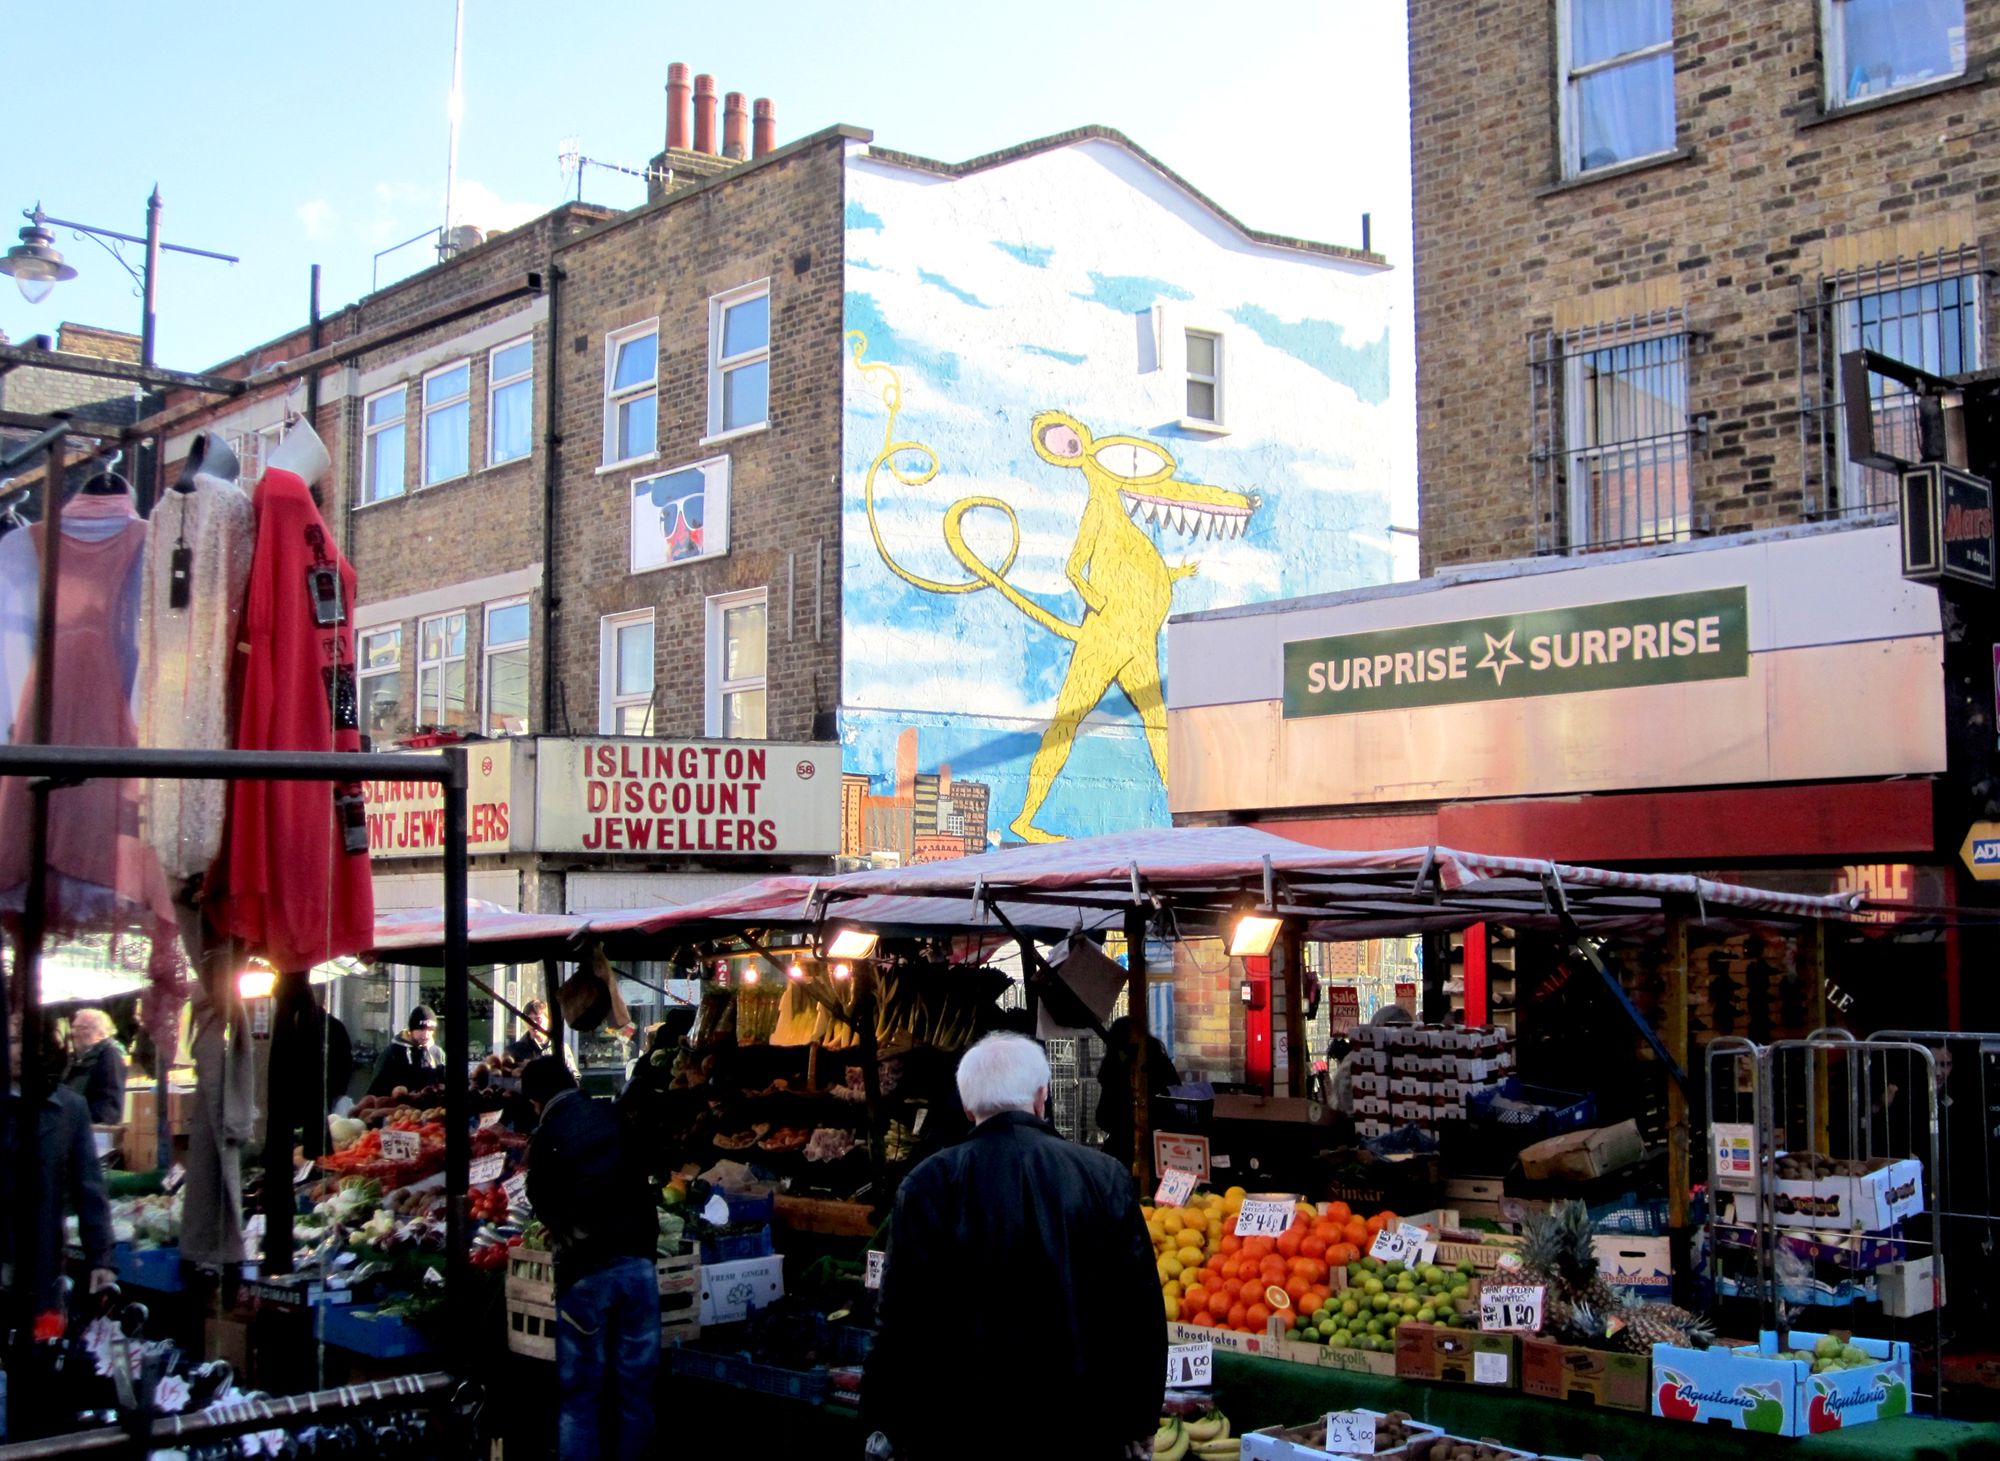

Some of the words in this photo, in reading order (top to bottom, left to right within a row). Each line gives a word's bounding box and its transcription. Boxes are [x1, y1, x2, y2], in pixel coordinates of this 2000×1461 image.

[1944, 505, 1992, 541] Mars
[1307, 645, 1468, 694] SURPRISE
[1529, 616, 1721, 670] SURPRISE
[584, 745, 766, 781] ISLINGTON
[797, 765, 814, 776] 58
[587, 780, 762, 815] DISCOUNT
[582, 817, 778, 851] JEWELLERS
[1880, 911, 1896, 923] ON
[1332, 990, 1357, 1003] sale
[1256, 1214, 1266, 1231] 4
[741, 1268, 769, 1279] GINGER
[1678, 1384, 1755, 1409] Aquitania
[1825, 1385, 1886, 1415] Aquitania
[1331, 1415, 1359, 1425] KIWI
[1333, 1428, 1342, 1443] 6
